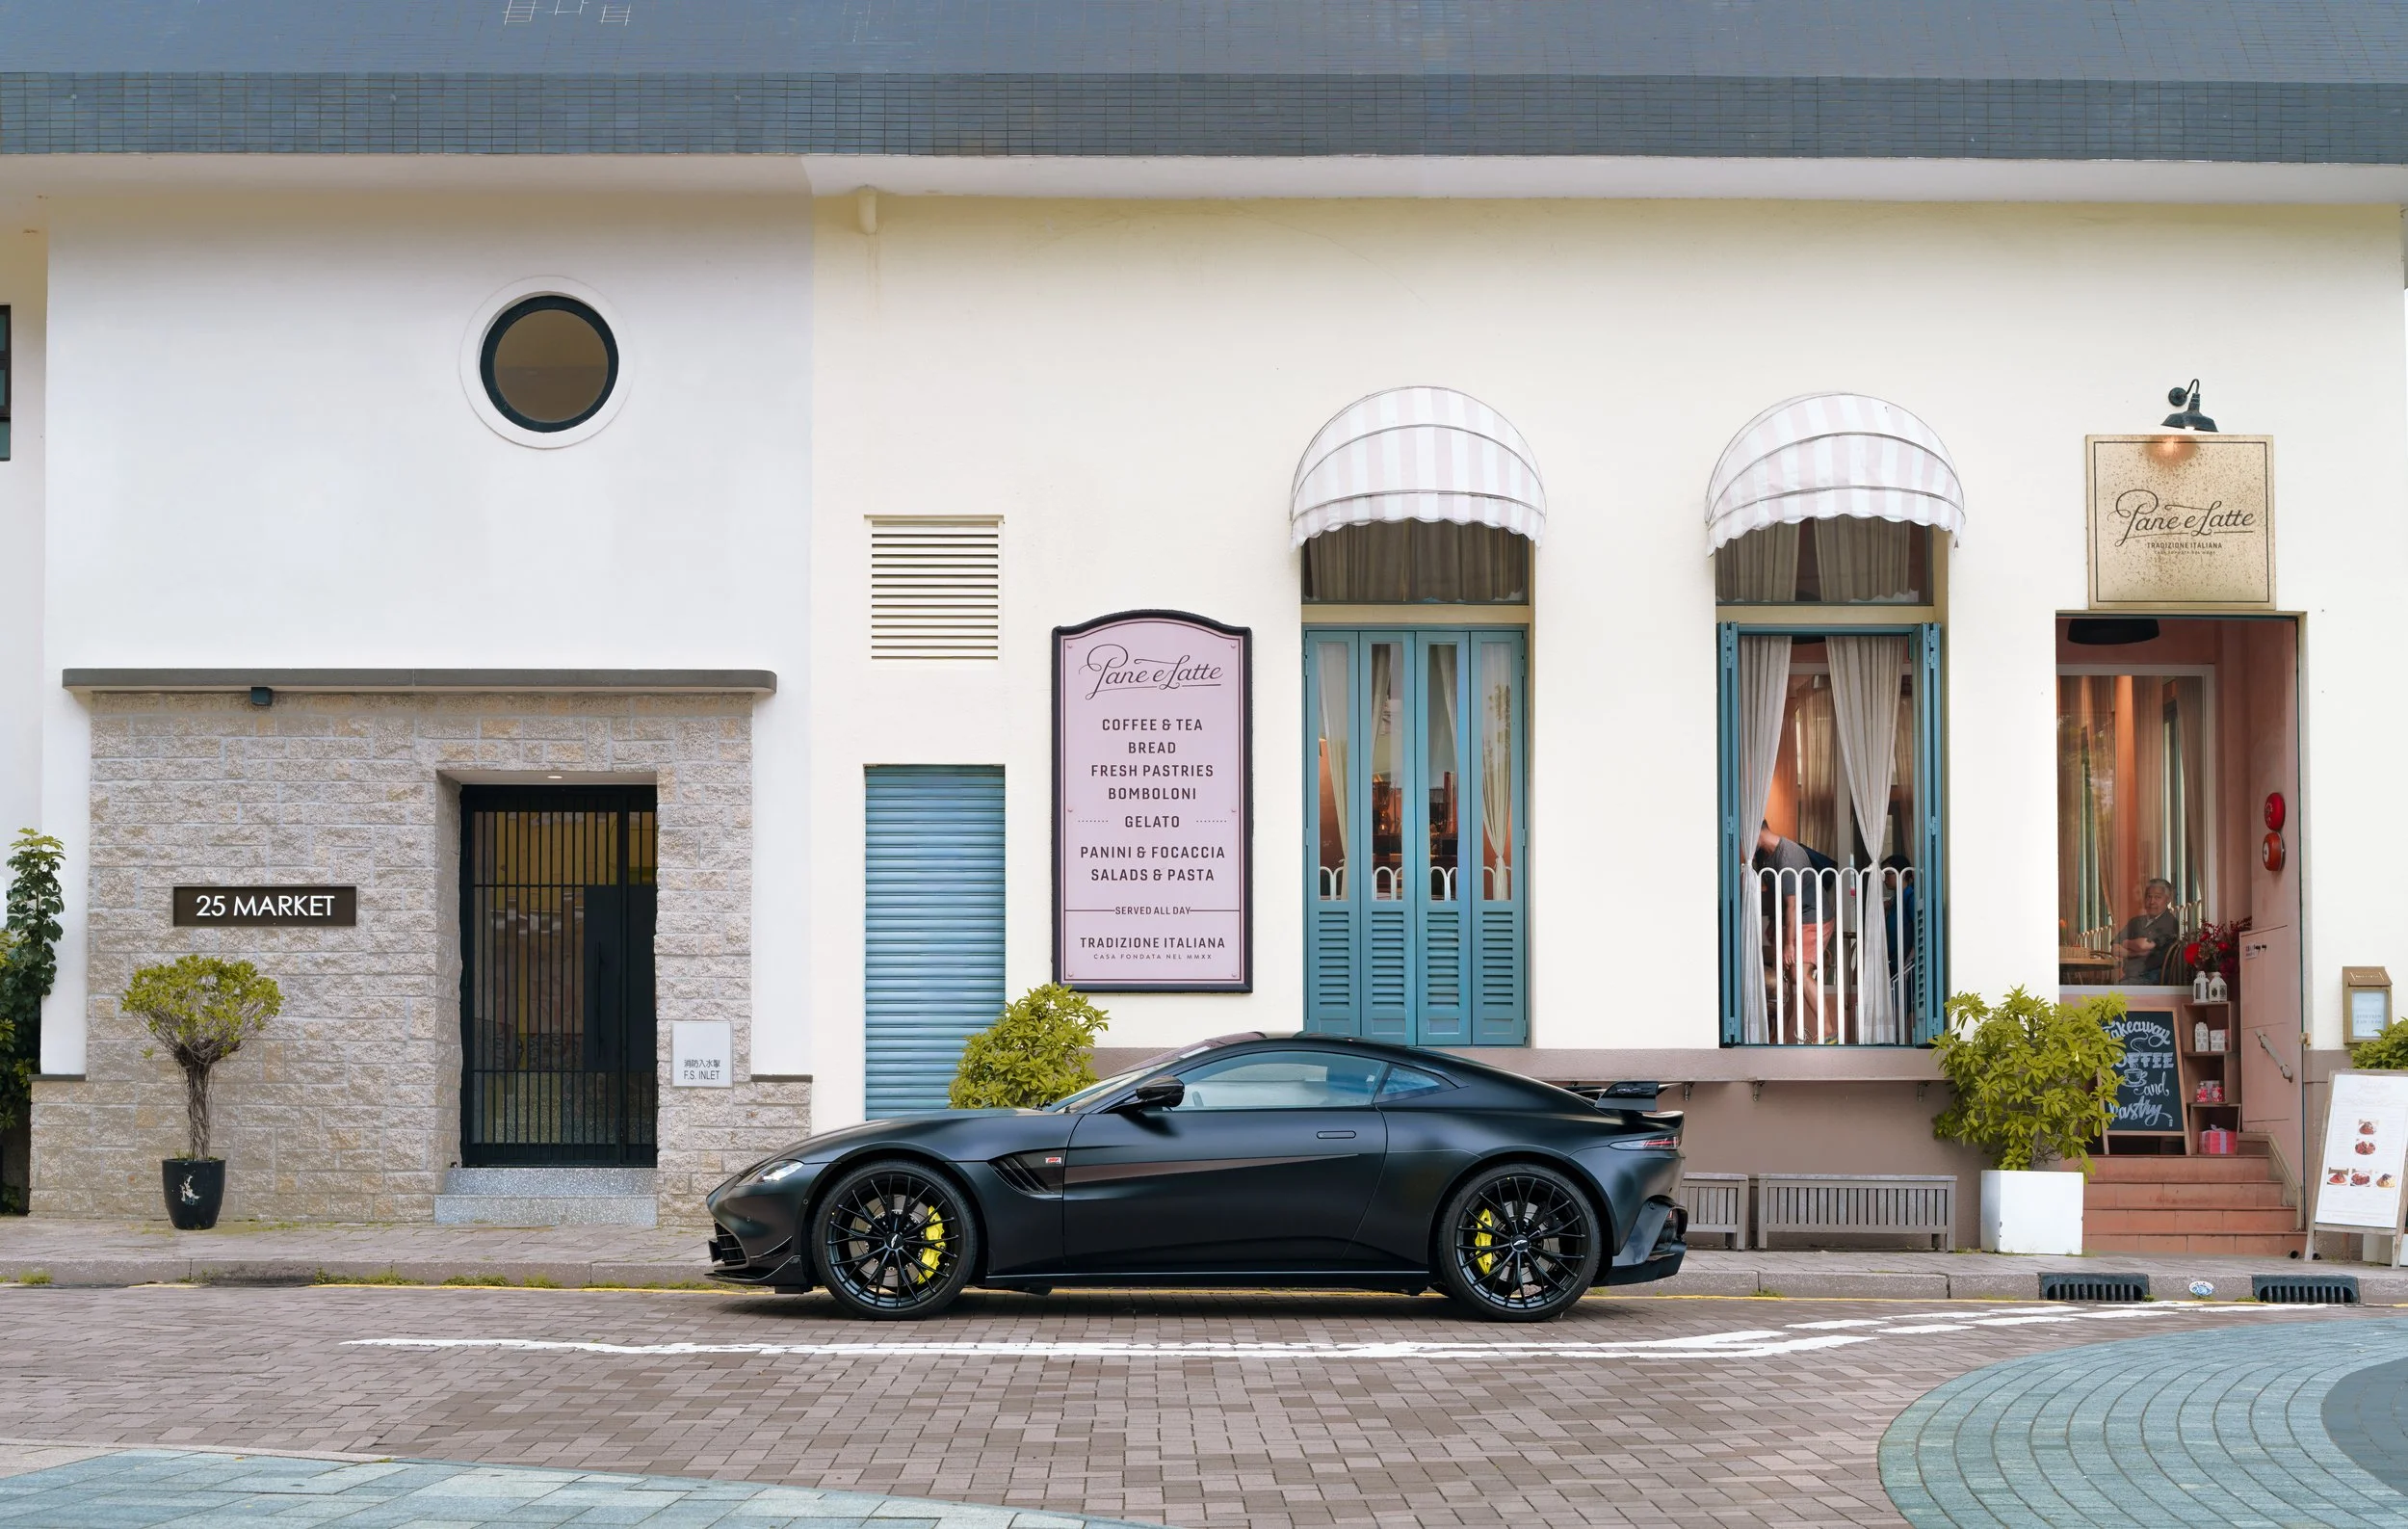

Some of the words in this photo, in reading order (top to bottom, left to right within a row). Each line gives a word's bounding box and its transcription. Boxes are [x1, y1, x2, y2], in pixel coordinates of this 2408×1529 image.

[2107, 489, 2181, 547] Pane
[2165, 501, 2256, 537] Latte
[1079, 644, 1149, 700] Pane
[1134, 655, 1222, 690] Latte
[1103, 719, 1157, 730] COFFEE
[1163, 719, 1171, 730] &
[1176, 719, 1202, 730] TEA
[1129, 742, 1175, 753] BREAD
[1092, 765, 1137, 777] FRESH
[1143, 765, 1213, 777] PASTRIES
[1109, 788, 1195, 800] BOMBOLONI
[1125, 816, 1179, 828] GELATO
[1081, 847, 1131, 858] PANINI
[1138, 847, 1146, 858] &
[1152, 847, 1224, 858] FOCACCIA
[1091, 869, 1147, 881] SALADS
[1153, 869, 1162, 881] &
[1168, 869, 1214, 881] PASTA
[196, 895, 225, 916] 25
[234, 896, 334, 915] MARKET
[1081, 937, 1159, 948] TRADIZIONE
[1165, 937, 1224, 948] ITALIANA
[2110, 1052, 2174, 1068] OFFEE
[684, 1070, 696, 1080] F.S.
[698, 1070, 720, 1080] INLET
[2133, 1071, 2170, 1096] and
